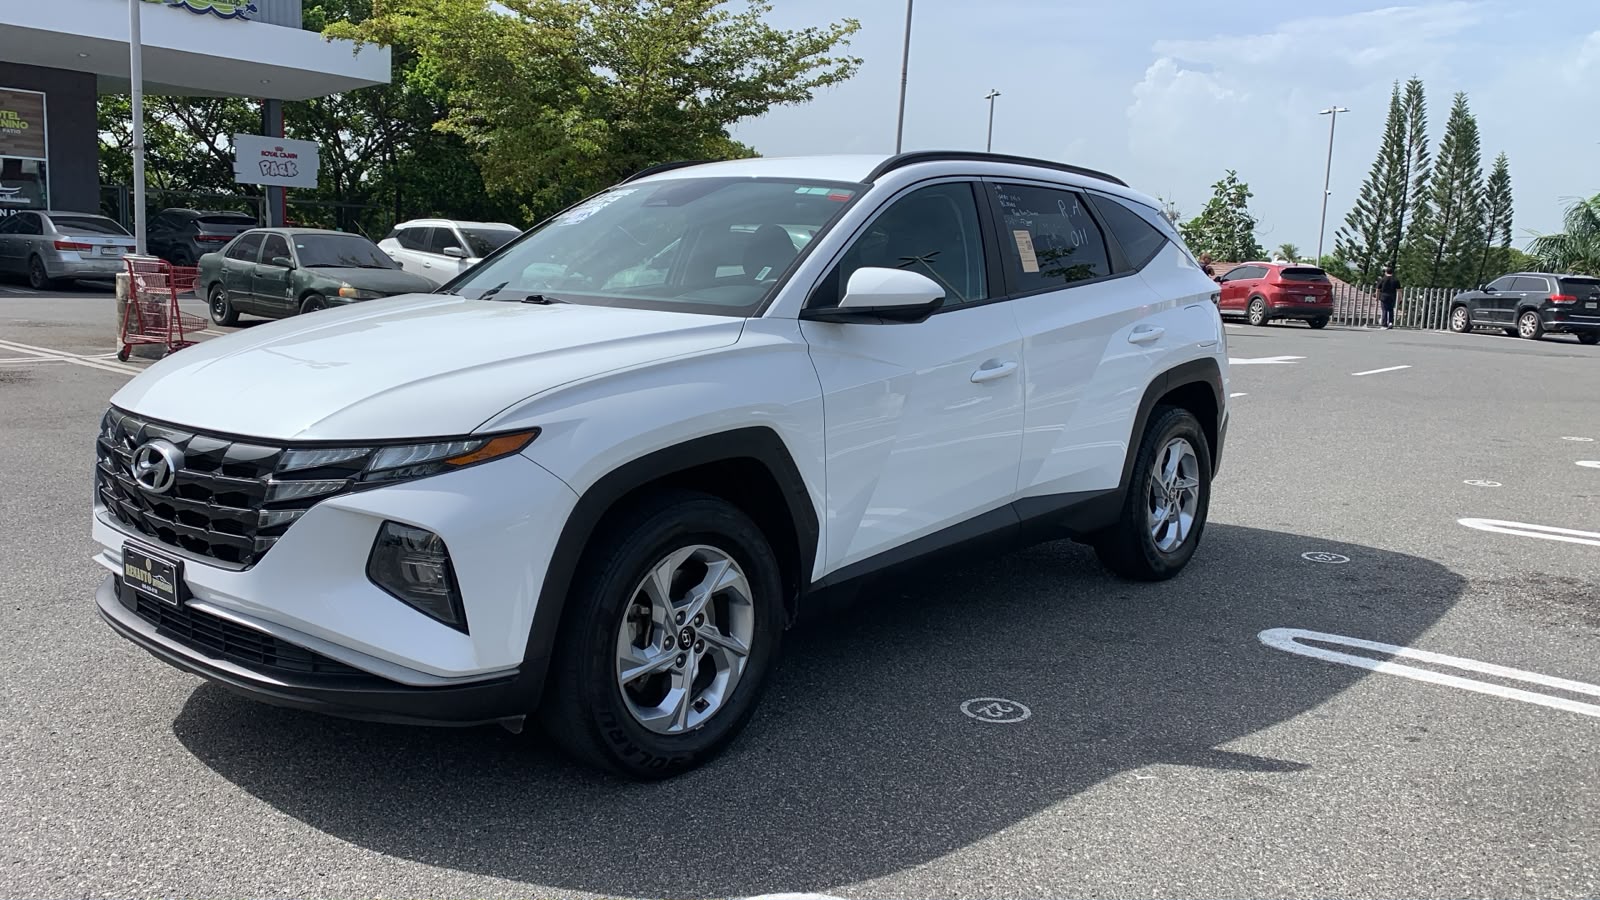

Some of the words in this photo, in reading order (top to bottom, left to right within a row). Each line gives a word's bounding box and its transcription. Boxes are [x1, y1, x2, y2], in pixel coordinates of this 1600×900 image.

[0, 110, 20, 120] TEL
[0, 118, 29, 129] NINO
[261, 150, 279, 158] ROYAL
[259, 160, 299, 177] PARK
